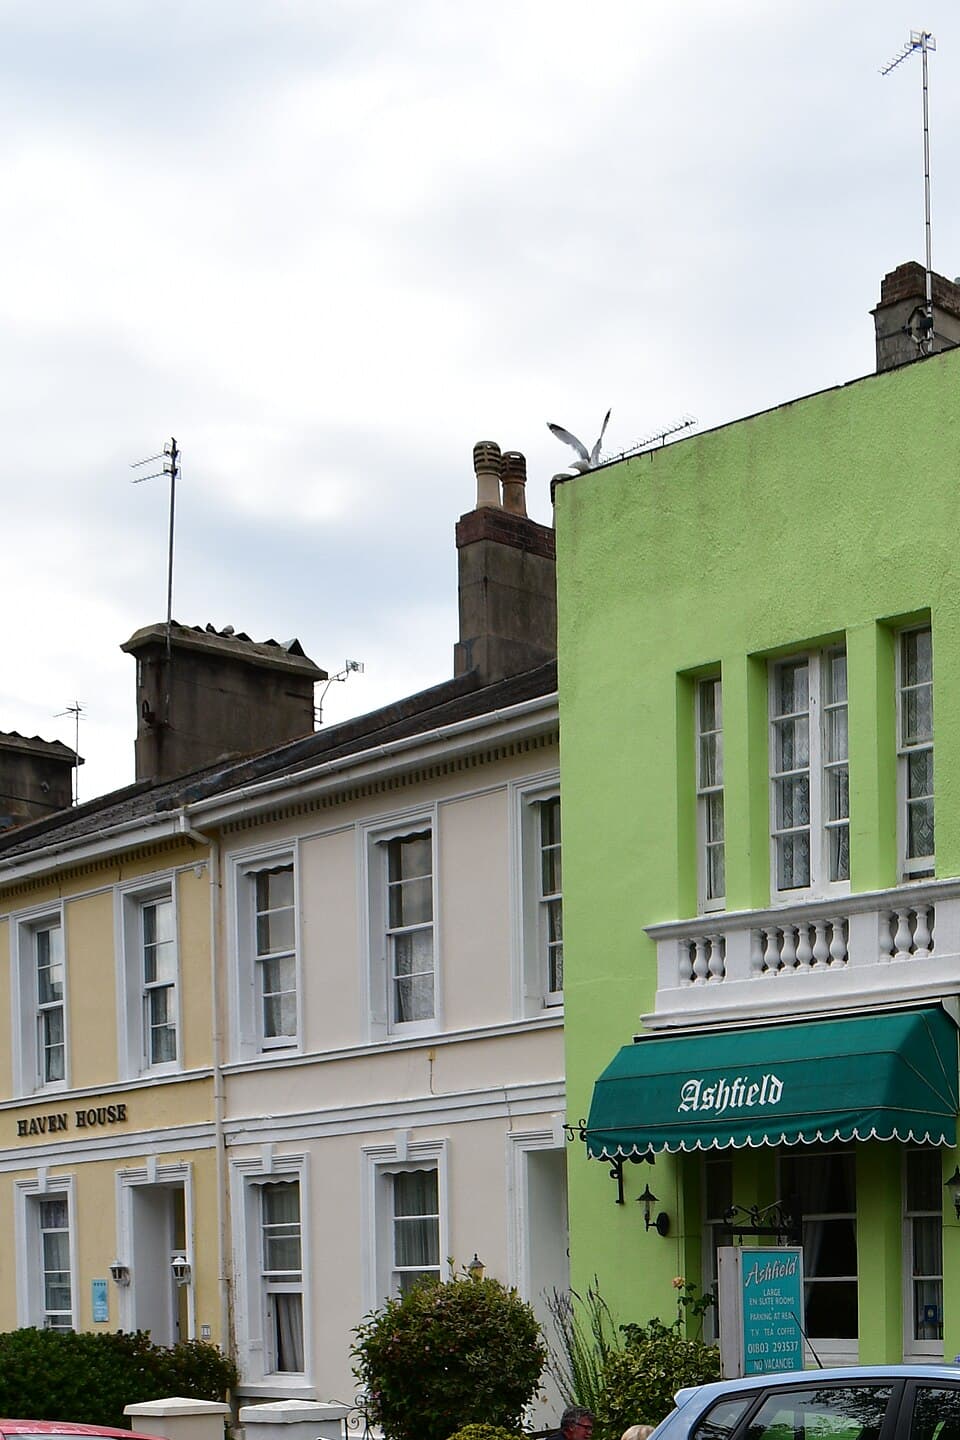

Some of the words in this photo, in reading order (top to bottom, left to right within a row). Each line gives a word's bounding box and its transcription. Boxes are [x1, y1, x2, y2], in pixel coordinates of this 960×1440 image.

[678, 1073, 784, 1116] Ashfield
[17, 1113, 69, 1137] HAVEN
[75, 1104, 128, 1128] HOUSE
[745, 1255, 798, 1288] Ashfield
[763, 1288, 781, 1297] LARGE
[775, 1296, 795, 1305] ROOMS
[750, 1313, 772, 1321] PARKING
[764, 1328, 774, 1337] TEA
[776, 1327, 796, 1336] COFFEE
[747, 1342, 769, 1354] 01803
[772, 1341, 798, 1353] 293537
[753, 1360, 763, 1371] NO
[764, 1357, 794, 1369] VACANCIES
